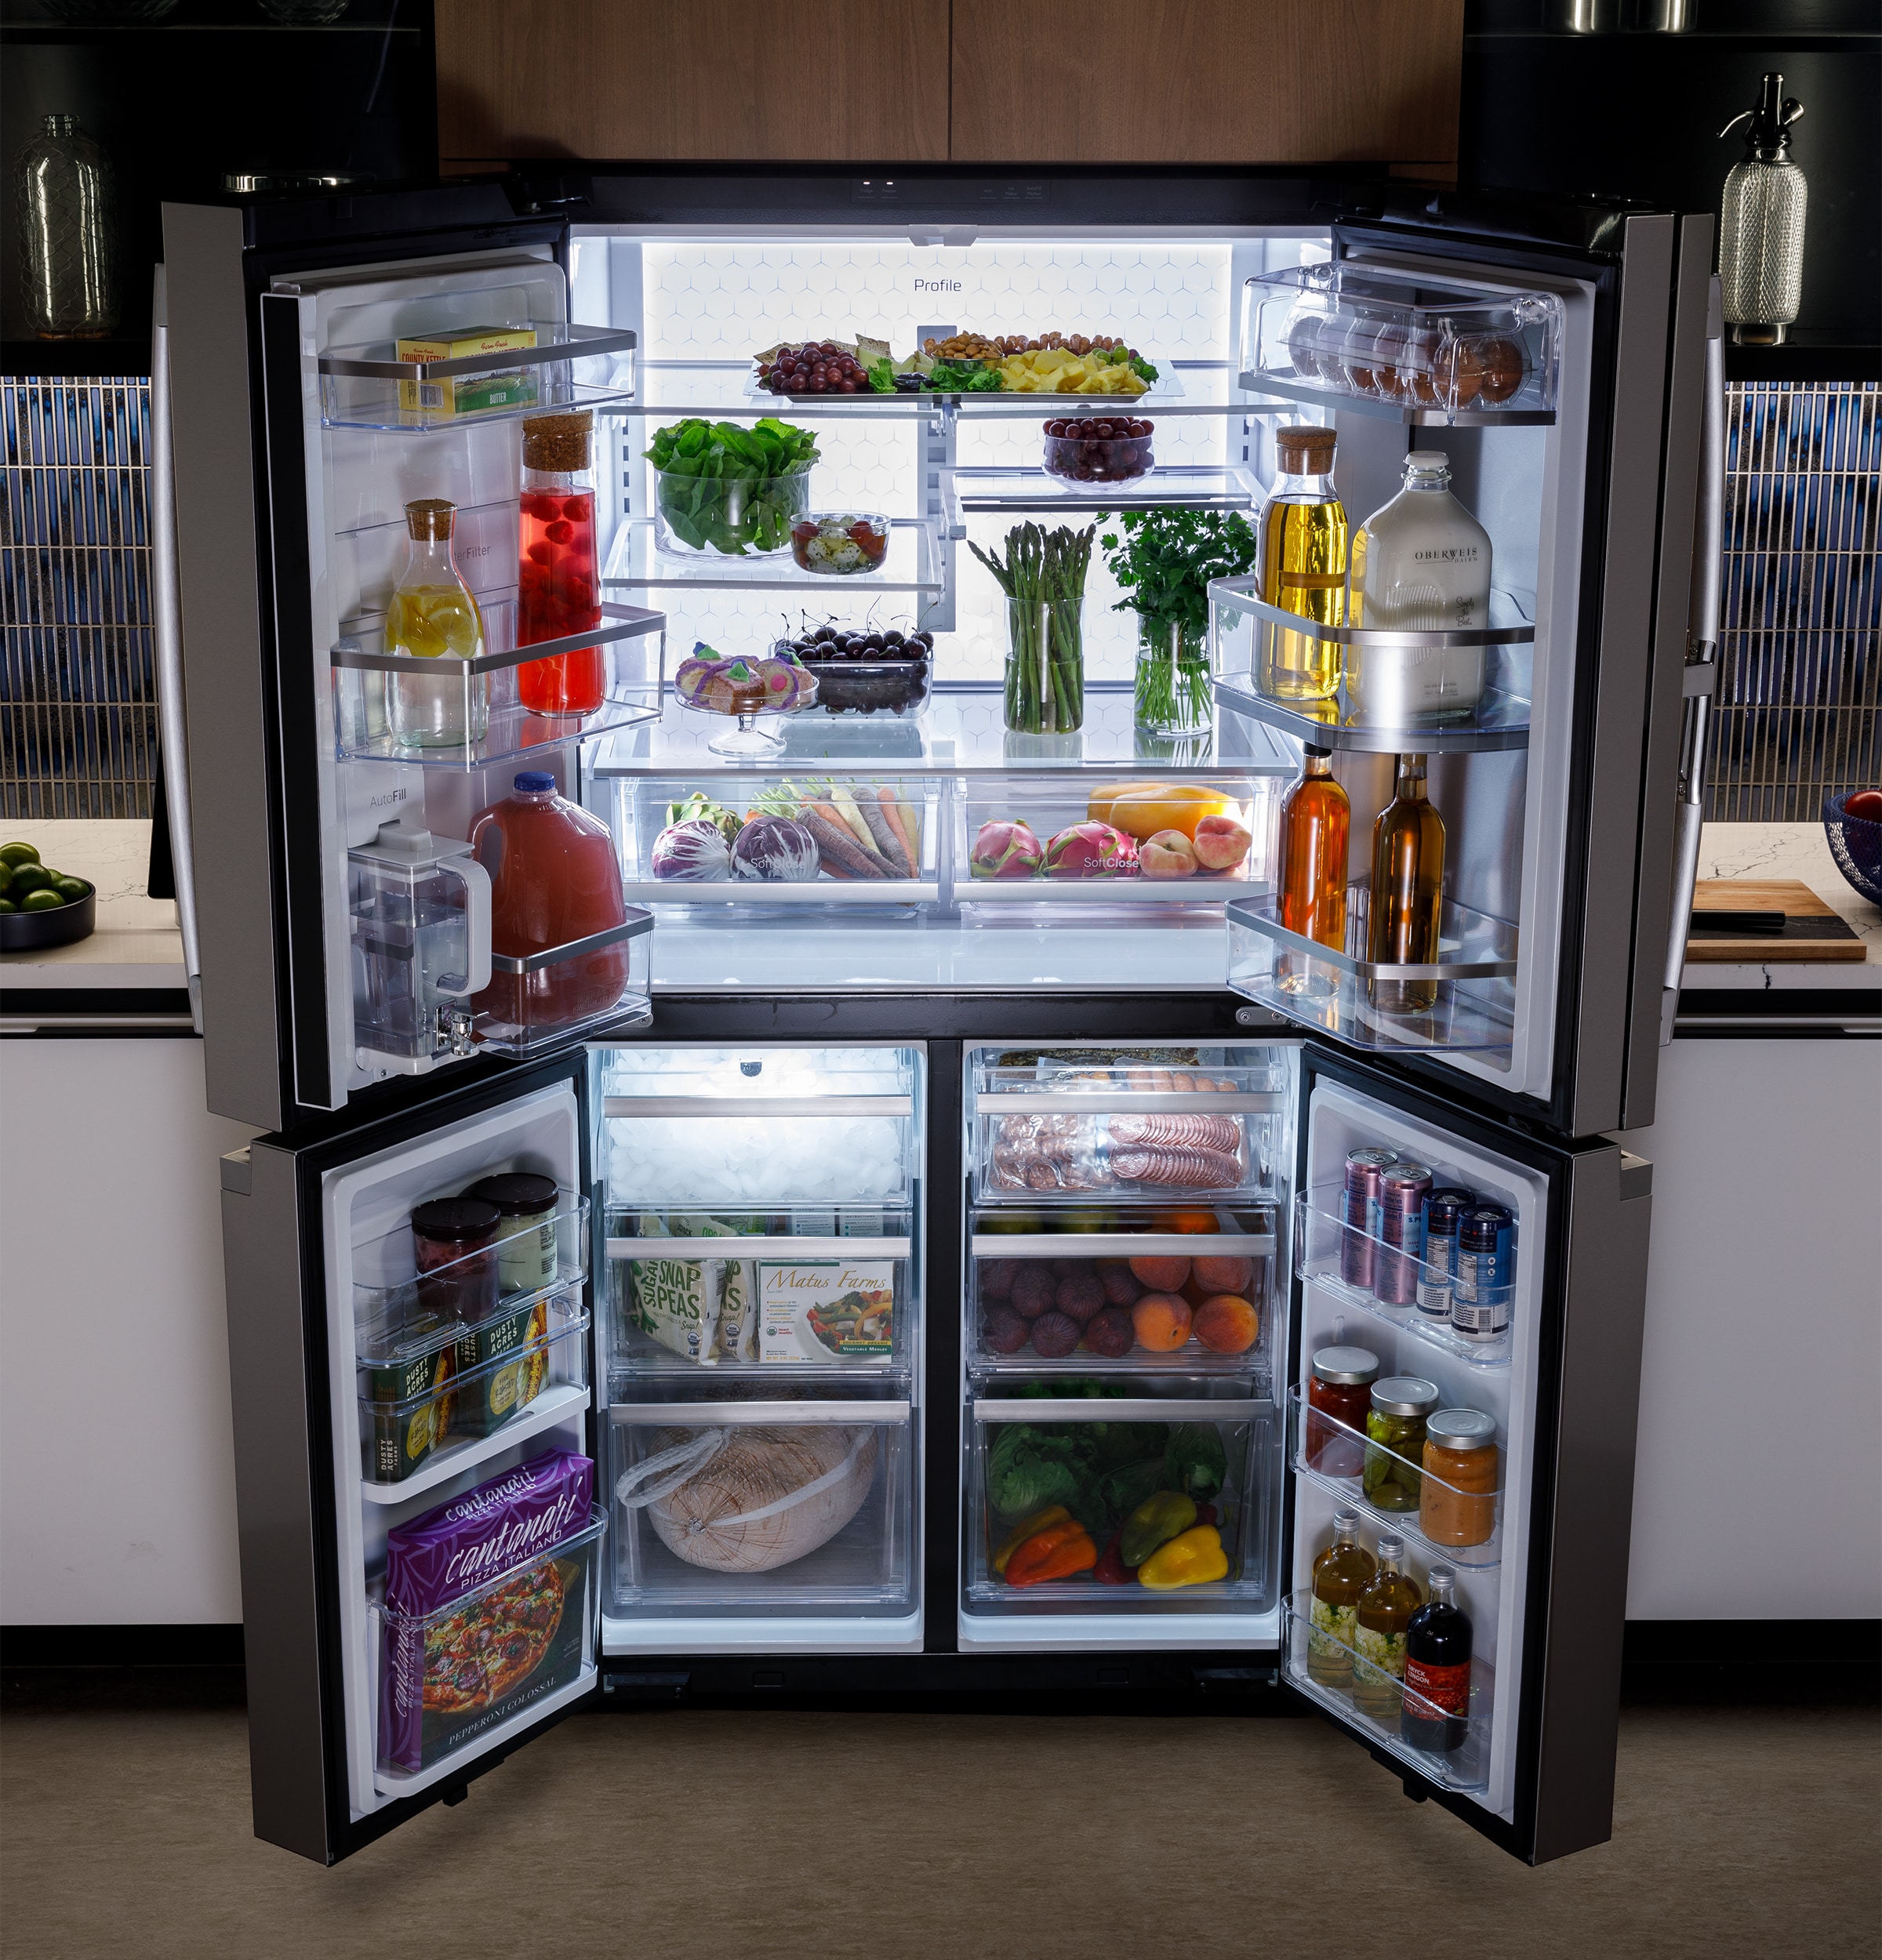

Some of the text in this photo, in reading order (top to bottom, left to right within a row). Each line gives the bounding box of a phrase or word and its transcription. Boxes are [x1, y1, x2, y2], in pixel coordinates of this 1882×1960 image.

[914, 278, 962, 292] Profile
[401, 353, 424, 363] COUNTY
[489, 392, 507, 405] BUTTER
[454, 545, 491, 562] terFilter
[1415, 547, 1477, 561] OBERWEIS
[369, 788, 406, 808] AutoFill
[1084, 857, 1139, 868] SoftClose
[659, 1260, 701, 1292] SNAP
[766, 1269, 886, 1290] Matus Farms
[657, 1285, 700, 1320] PEAS
[490, 1316, 517, 1343] DUSTY
[681, 1320, 699, 1331] Snap!
[491, 1327, 518, 1355] ACRES
[406, 1356, 428, 1386] DUSTY
[406, 1367, 429, 1397] ACRES
[466, 1483, 537, 1520] PIZZA ITALIANO
[461, 1529, 562, 1590] PIZZA ITALIANO
[1408, 1664, 1426, 1677] DRYCK
[1408, 1670, 1430, 1685] LINGON
[449, 1676, 557, 1745] PEPPERONI COLOSSAL
